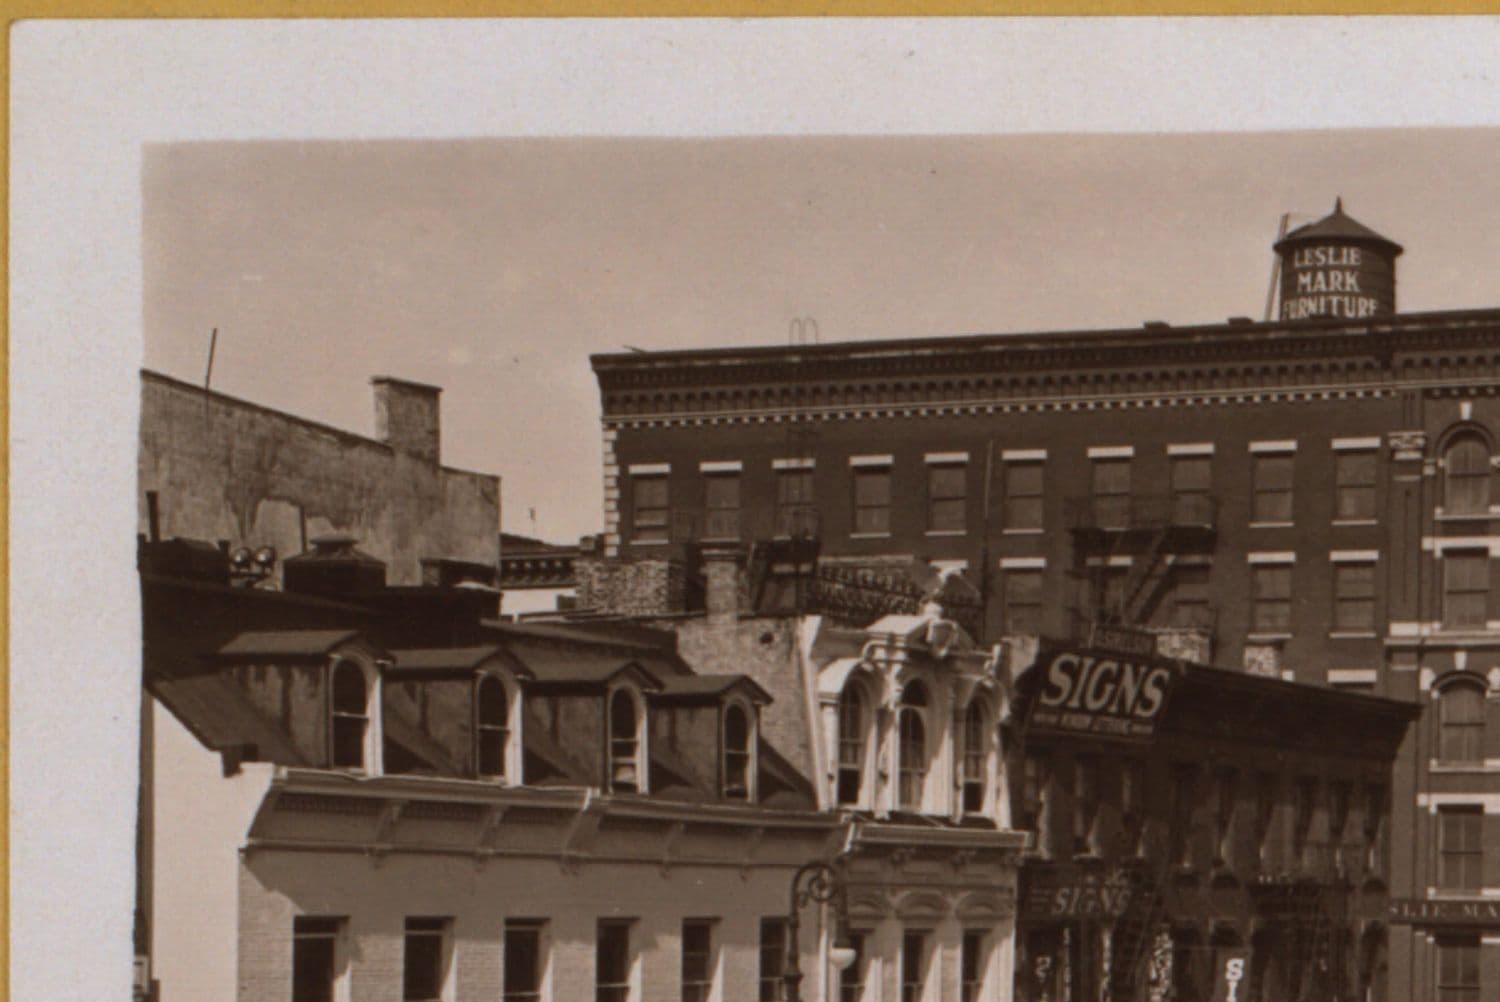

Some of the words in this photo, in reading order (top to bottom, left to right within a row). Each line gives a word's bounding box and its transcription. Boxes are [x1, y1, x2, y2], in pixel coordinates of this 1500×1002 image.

[1294, 246, 1362, 267] LESLIE
[1297, 270, 1360, 292] MARK
[1283, 294, 1378, 321] FURNITURE
[1040, 652, 1170, 718] SIGNS
[1052, 887, 1132, 917] SIGNS
